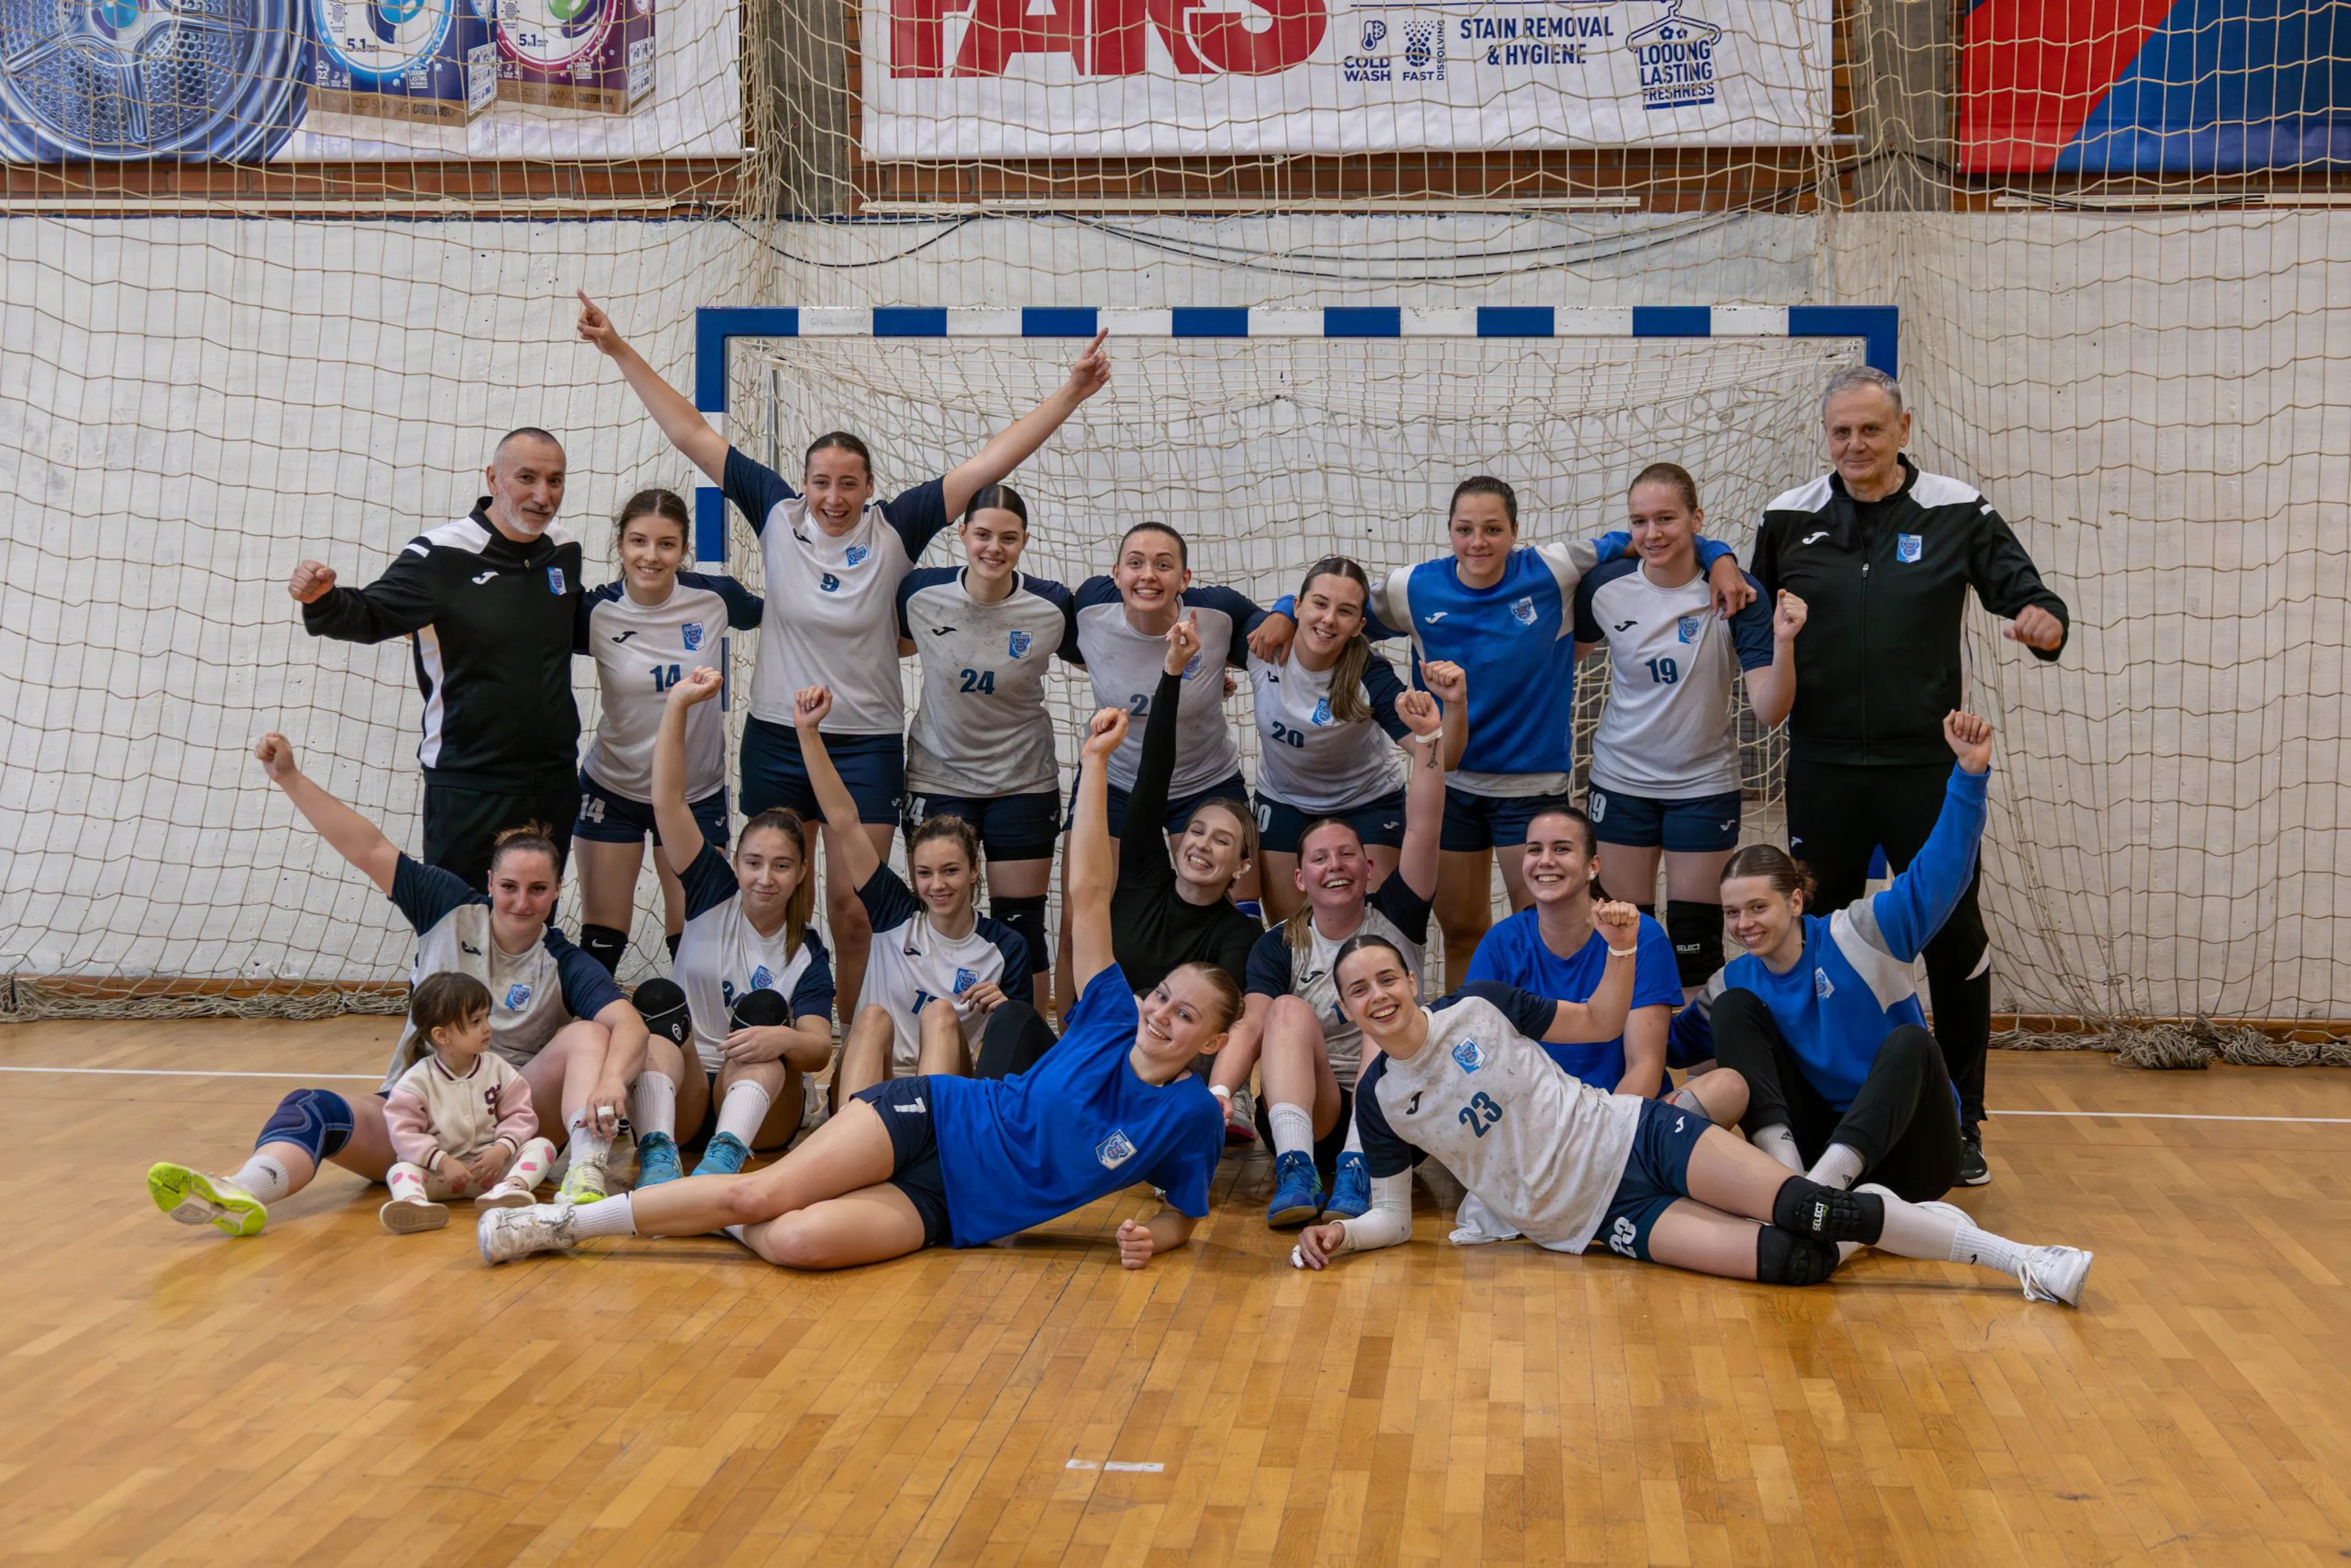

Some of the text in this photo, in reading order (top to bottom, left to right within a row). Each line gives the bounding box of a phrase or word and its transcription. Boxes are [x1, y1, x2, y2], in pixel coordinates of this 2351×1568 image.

[1461, 16, 1614, 39] STAIN REMOVAL
[1344, 56, 1390, 69] COLD
[1487, 44, 1587, 66] & HYGIENE
[1638, 40, 1711, 66] LOOONG
[1344, 70, 1391, 81] WASH
[1403, 72, 1434, 81] FAST
[1640, 62, 1712, 86] LASTING
[819, 572, 840, 592] 9
[650, 664, 681, 692] 14
[960, 669, 996, 695] 24
[1645, 657, 1679, 685] 19
[1271, 721, 1305, 748] 20
[580, 793, 606, 824] 14
[903, 791, 926, 827] 24
[1588, 790, 1607, 823] 19
[1676, 943, 1701, 953] SELECT
[911, 989, 939, 1015] 1
[1458, 1090, 1502, 1138] 23
[1812, 1201, 1825, 1231] SELECT
[1609, 1216, 1637, 1259] 23
